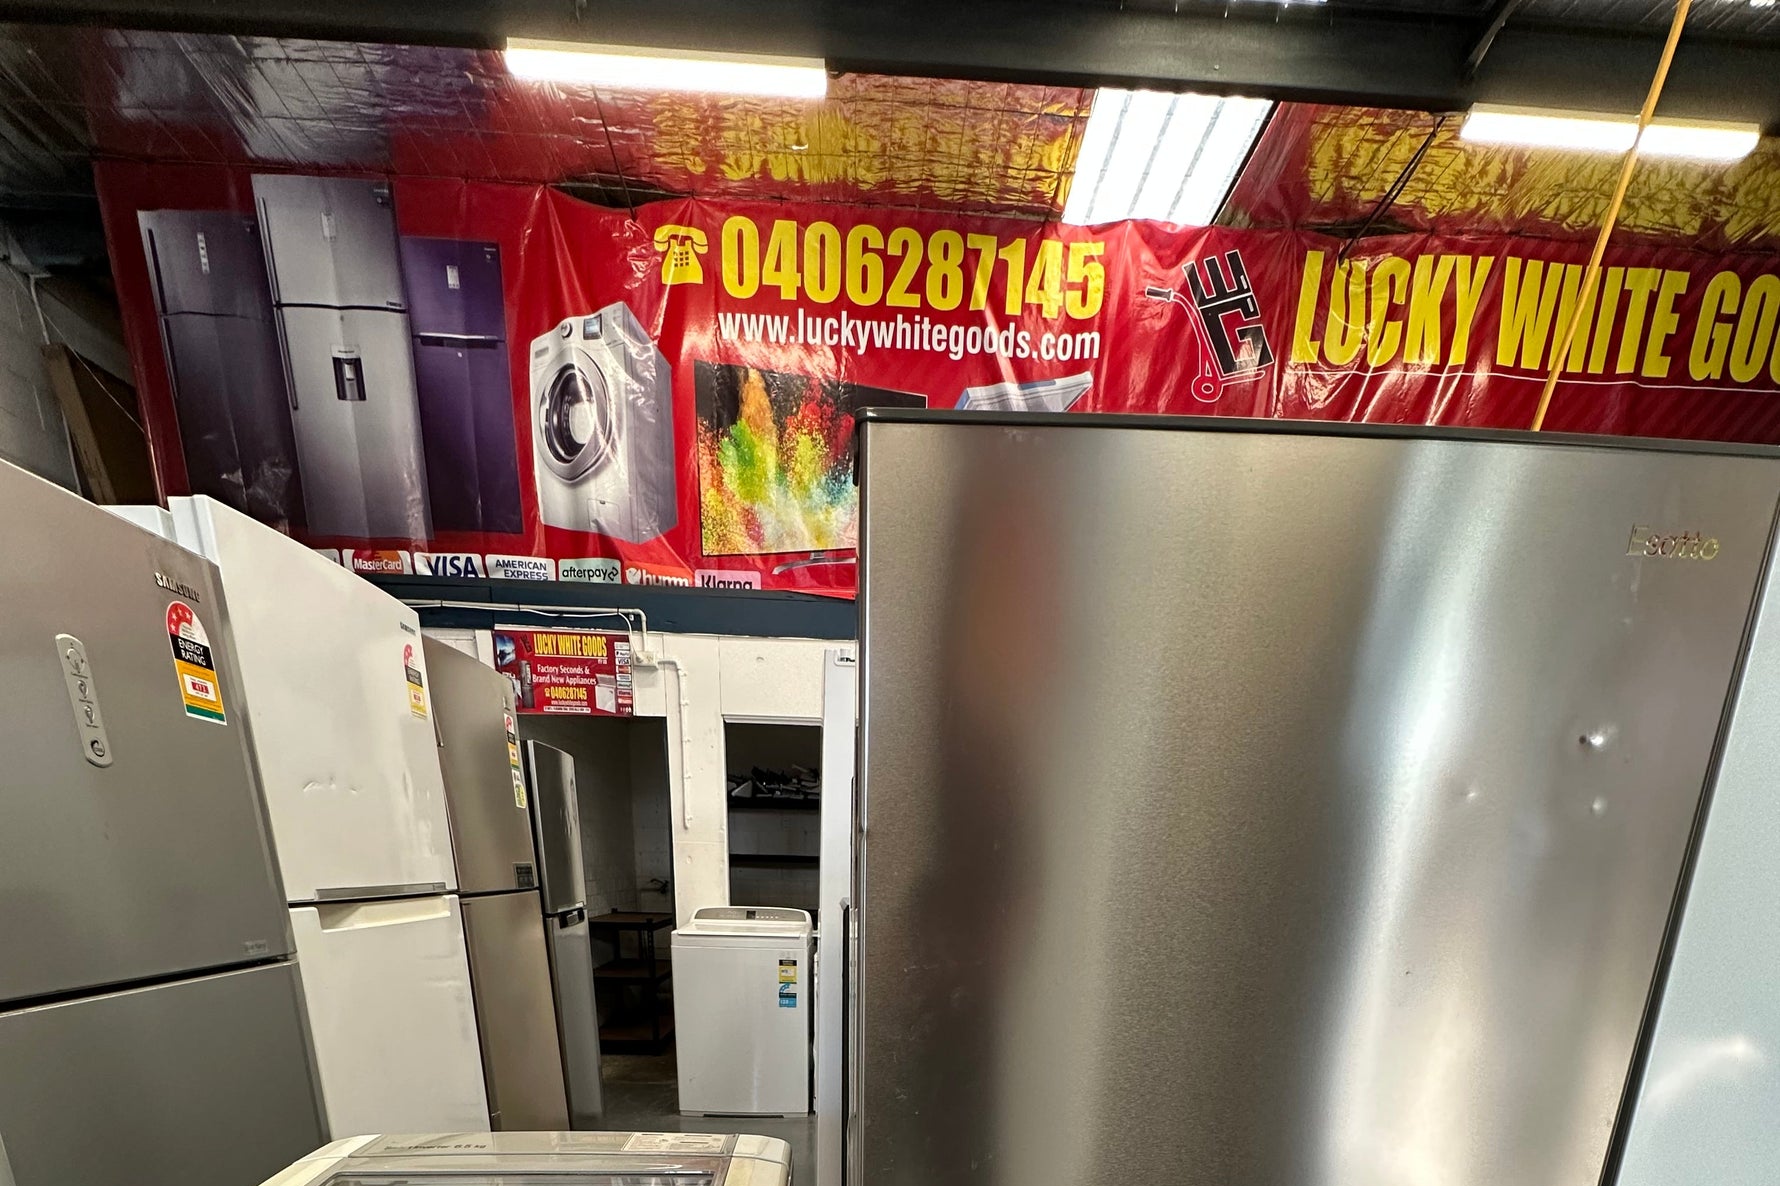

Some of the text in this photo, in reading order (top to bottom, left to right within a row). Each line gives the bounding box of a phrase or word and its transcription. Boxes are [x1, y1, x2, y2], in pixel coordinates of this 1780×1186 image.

[721, 215, 1106, 321] 0406287145
[1290, 249, 1495, 366] LUCKY
[1496, 256, 1689, 379] WHITE
[718, 308, 1100, 362] www.luckywhitegoods.com
[1625, 522, 1720, 561] Esatto
[353, 557, 403, 571] MasterCard
[424, 555, 480, 578] VISA
[495, 558, 548, 571] AMERICAN
[503, 568, 549, 581] EXPRESS
[562, 566, 608, 582] afterpay
[701, 574, 753, 590] Klarna
[154, 571, 201, 603] SAMSUNG
[178, 637, 204, 655] ENERGY
[533, 633, 557, 655] LUCKY
[557, 634, 582, 656] WHITE
[582, 635, 607, 657] GOODS
[181, 649, 206, 667] RATING
[537, 664, 590, 675] Factory Seconds &
[532, 674, 597, 686] Brand New Appliances
